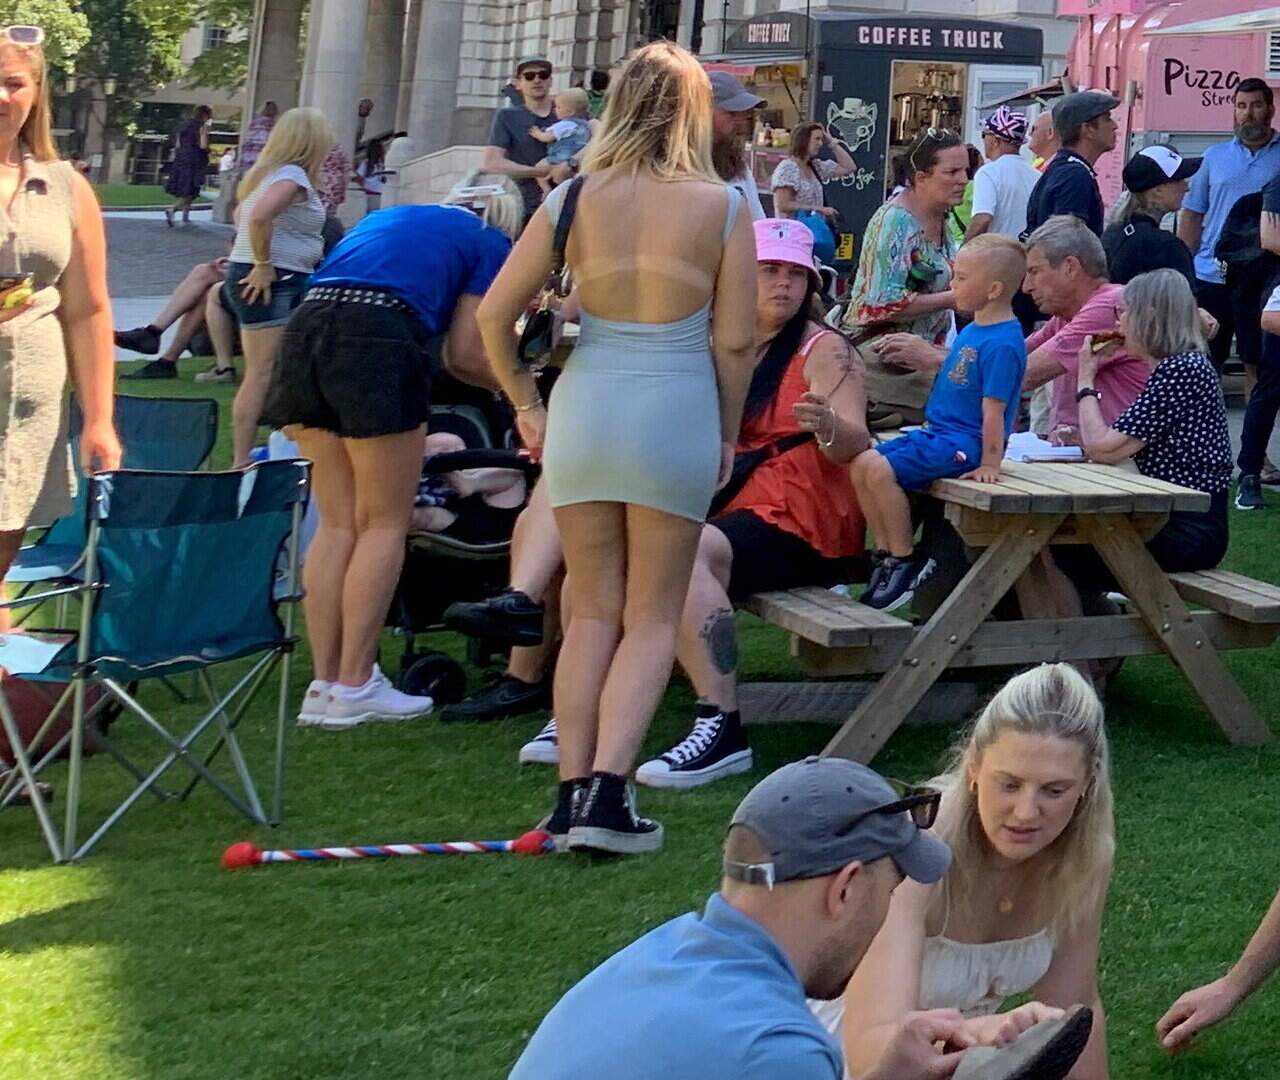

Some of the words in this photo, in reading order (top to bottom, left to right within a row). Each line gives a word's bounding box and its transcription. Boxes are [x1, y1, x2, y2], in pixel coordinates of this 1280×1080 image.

[748, 23, 769, 44] COFFEE
[770, 22, 792, 43] TRUCK
[858, 26, 932, 47] COFFEE
[942, 29, 1005, 49] TRUCK
[1164, 58, 1240, 95] Pizza
[856, 167, 876, 191] fox
